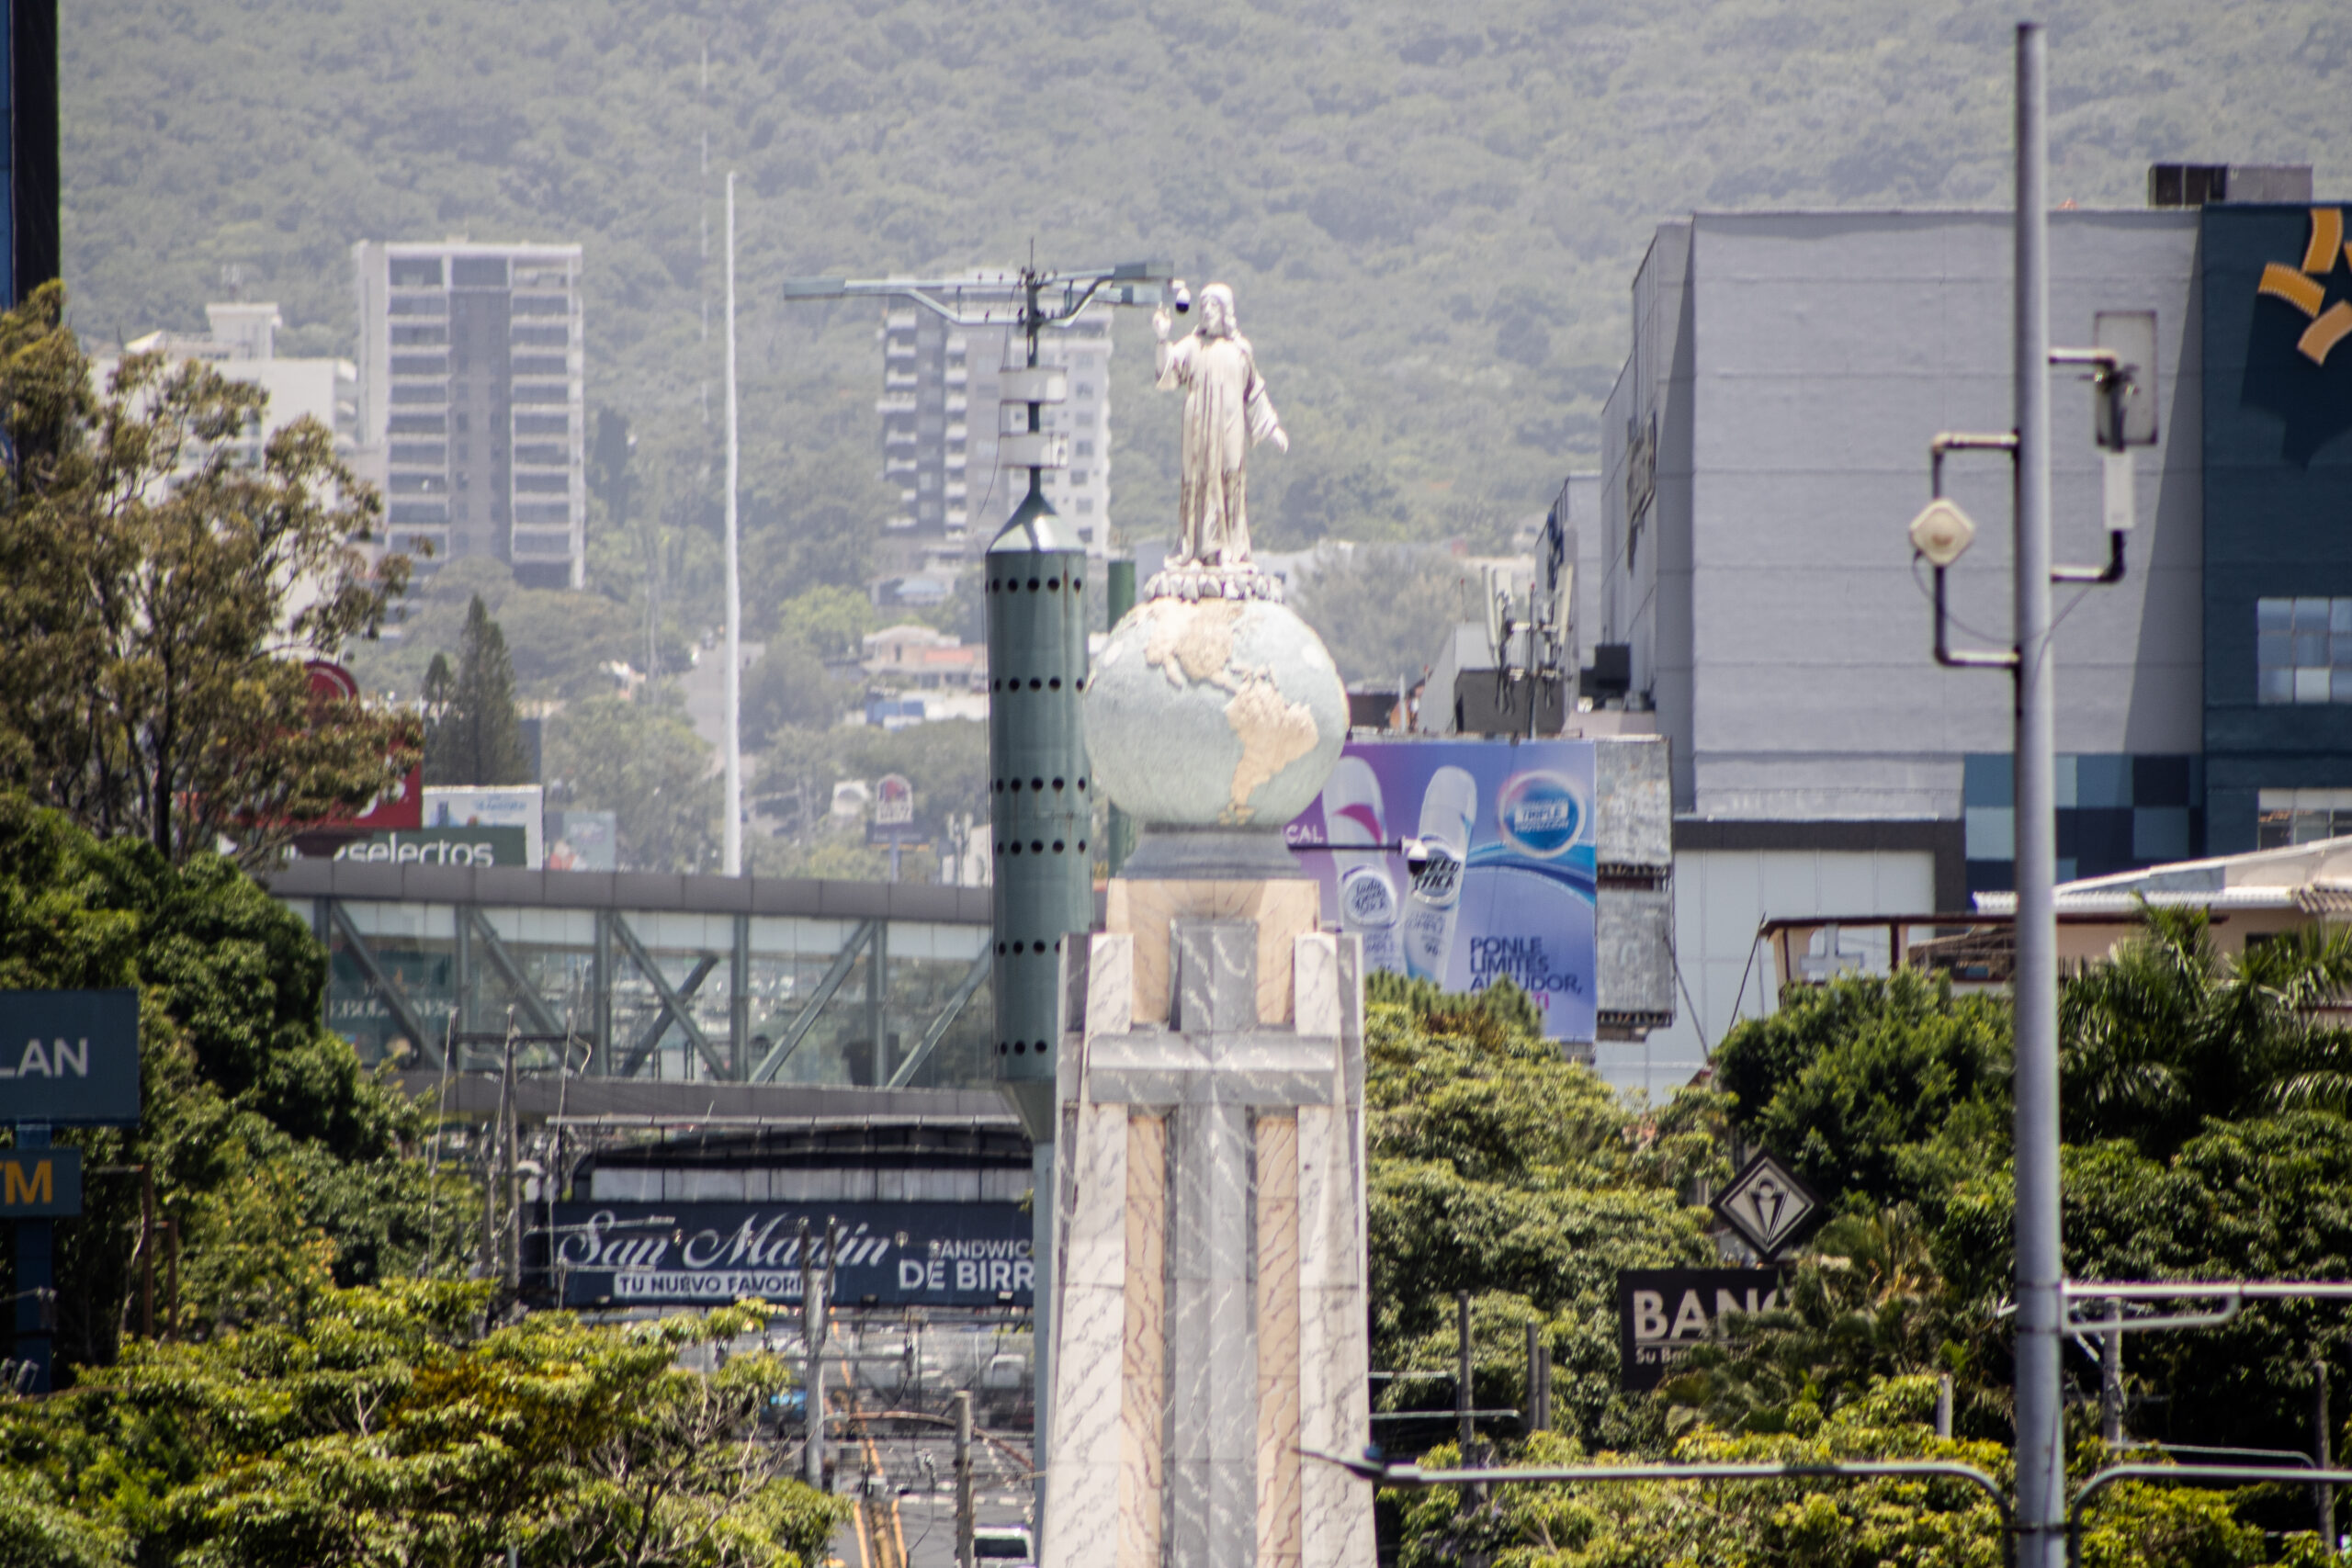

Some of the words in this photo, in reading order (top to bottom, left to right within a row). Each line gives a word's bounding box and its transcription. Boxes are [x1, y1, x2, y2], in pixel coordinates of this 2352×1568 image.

[348, 831, 494, 866] selectos
[1470, 936, 1543, 955] PONLE
[1470, 954, 1549, 974] LIMITES
[1514, 974, 1582, 995] UDOR,
[0, 1158, 53, 1205] M
[558, 1210, 671, 1266] San
[928, 1239, 1035, 1259] SANDWIC
[617, 1276, 643, 1293] TU
[651, 1276, 720, 1294] NUEVO
[728, 1276, 831, 1294] FAVORI
[899, 1258, 945, 1292] DE
